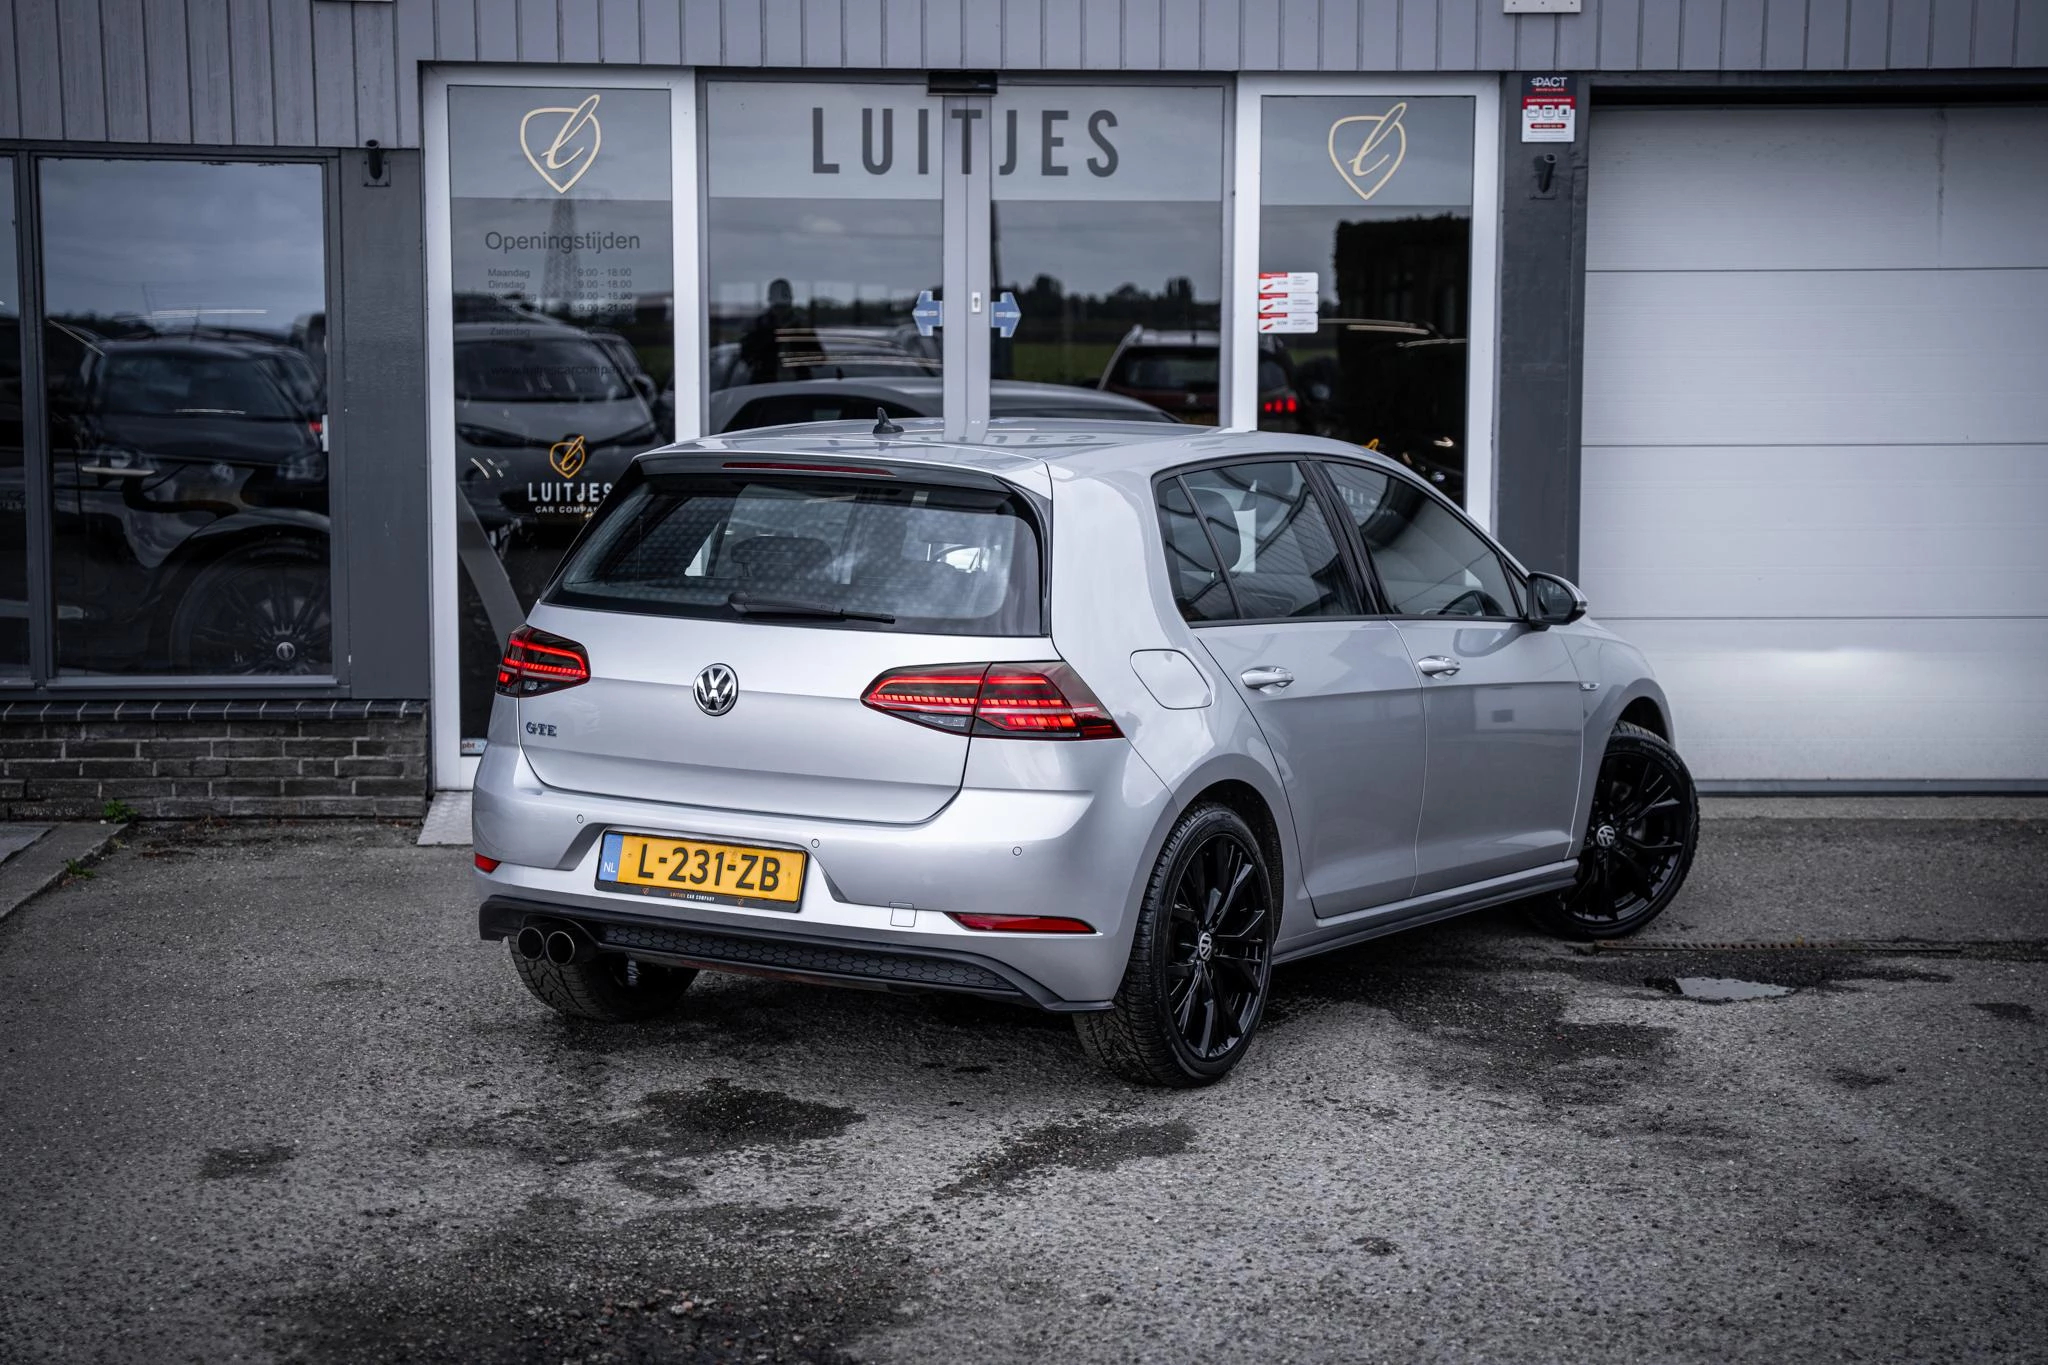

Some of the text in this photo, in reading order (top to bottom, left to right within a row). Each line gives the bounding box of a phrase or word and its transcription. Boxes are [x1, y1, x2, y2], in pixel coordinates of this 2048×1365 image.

[812, 107, 1119, 178] LUITJES
[485, 231, 641, 254] Openingstijden
[488, 268, 530, 279] Maandag
[535, 505, 555, 514] CAR
[525, 721, 558, 738] GTE
[603, 861, 617, 873] NL
[637, 843, 781, 892] L-231-ZB
